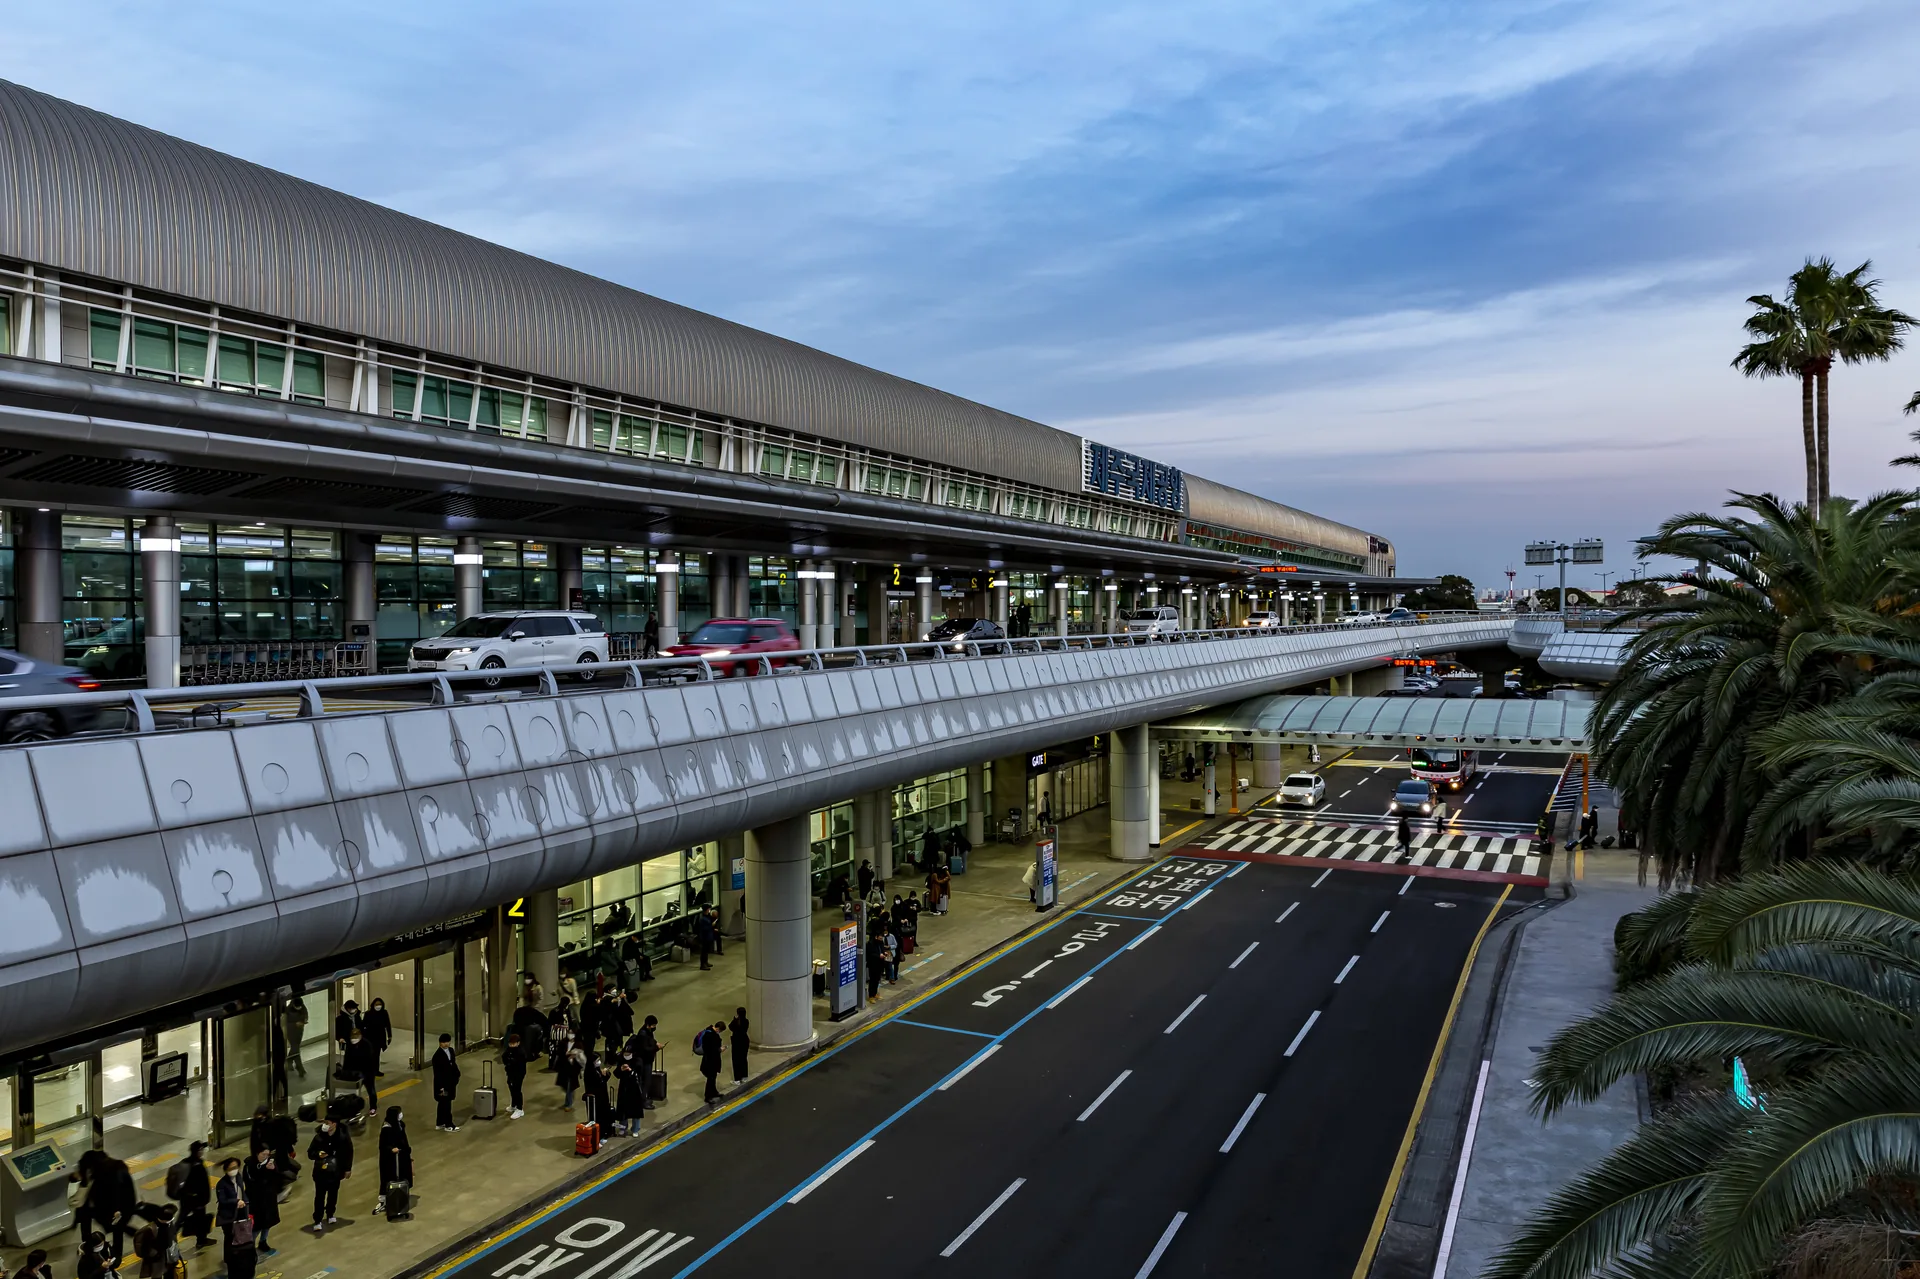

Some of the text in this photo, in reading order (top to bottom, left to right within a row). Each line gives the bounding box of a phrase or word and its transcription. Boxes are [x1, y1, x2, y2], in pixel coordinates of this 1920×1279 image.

[1090, 443, 1182, 511] 제주국제공항
[893, 568, 900, 585] 2
[1032, 754, 1044, 767] GATE
[1161, 860, 1228, 876] 성산
[1135, 874, 1208, 892] 표선
[845, 902, 853, 913] 2
[1105, 890, 1182, 911] 남원
